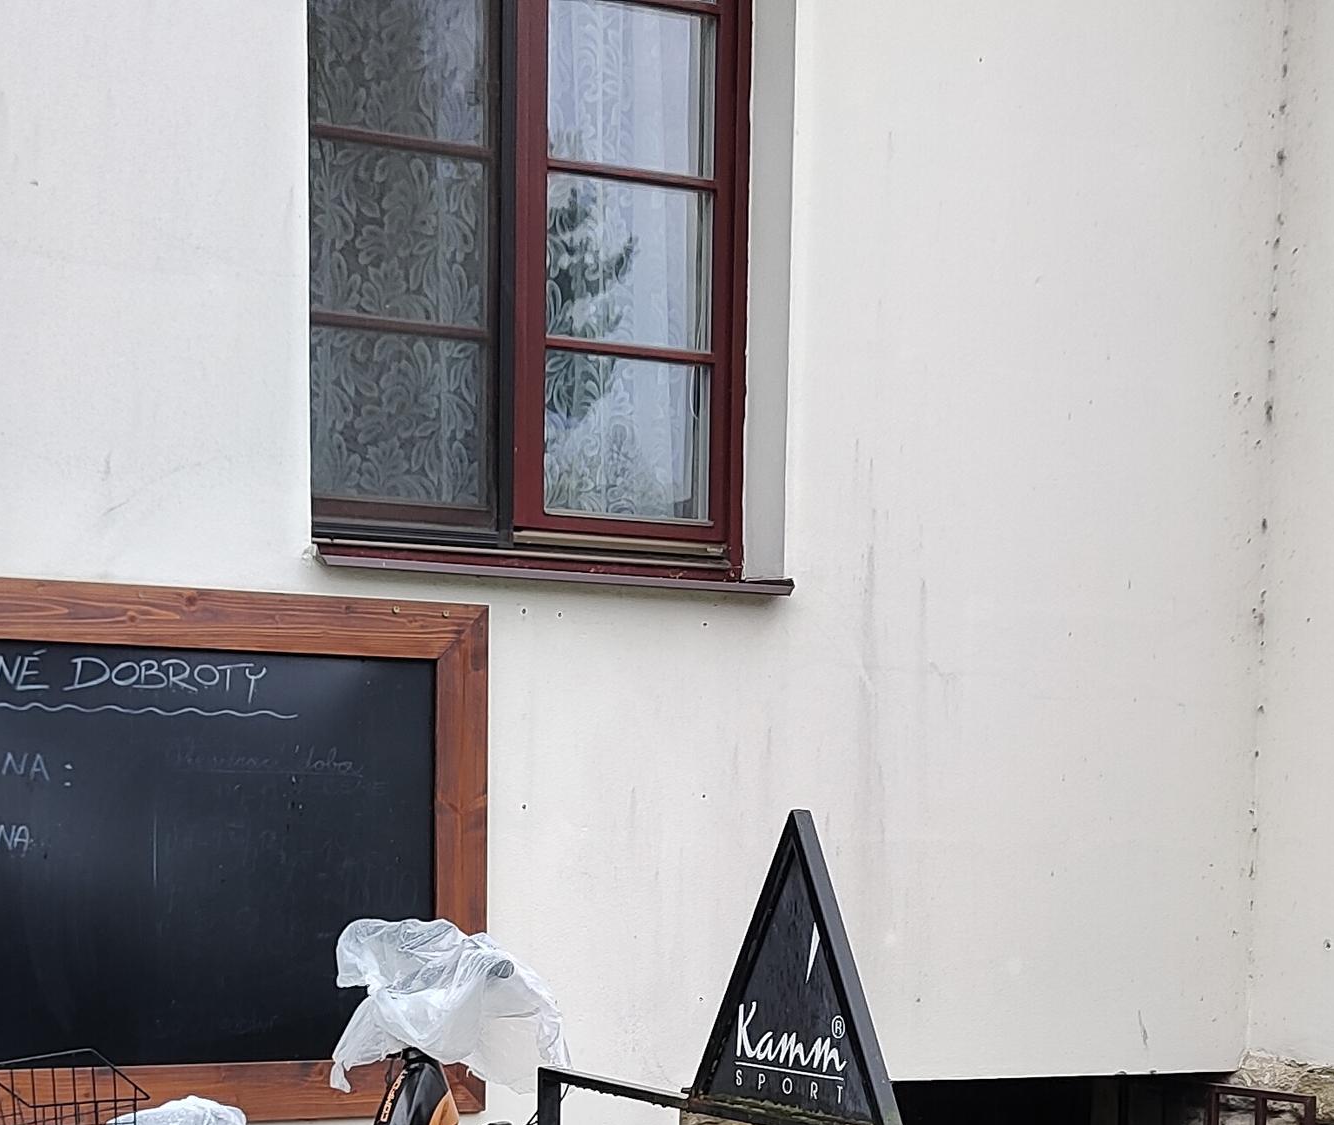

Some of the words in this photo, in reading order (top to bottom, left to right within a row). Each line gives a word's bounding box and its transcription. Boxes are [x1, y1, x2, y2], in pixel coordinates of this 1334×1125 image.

[64, 657, 267, 703] DOBROTY
[1, 752, 49, 781] NA
[735, 1069, 845, 1105] SPORT
